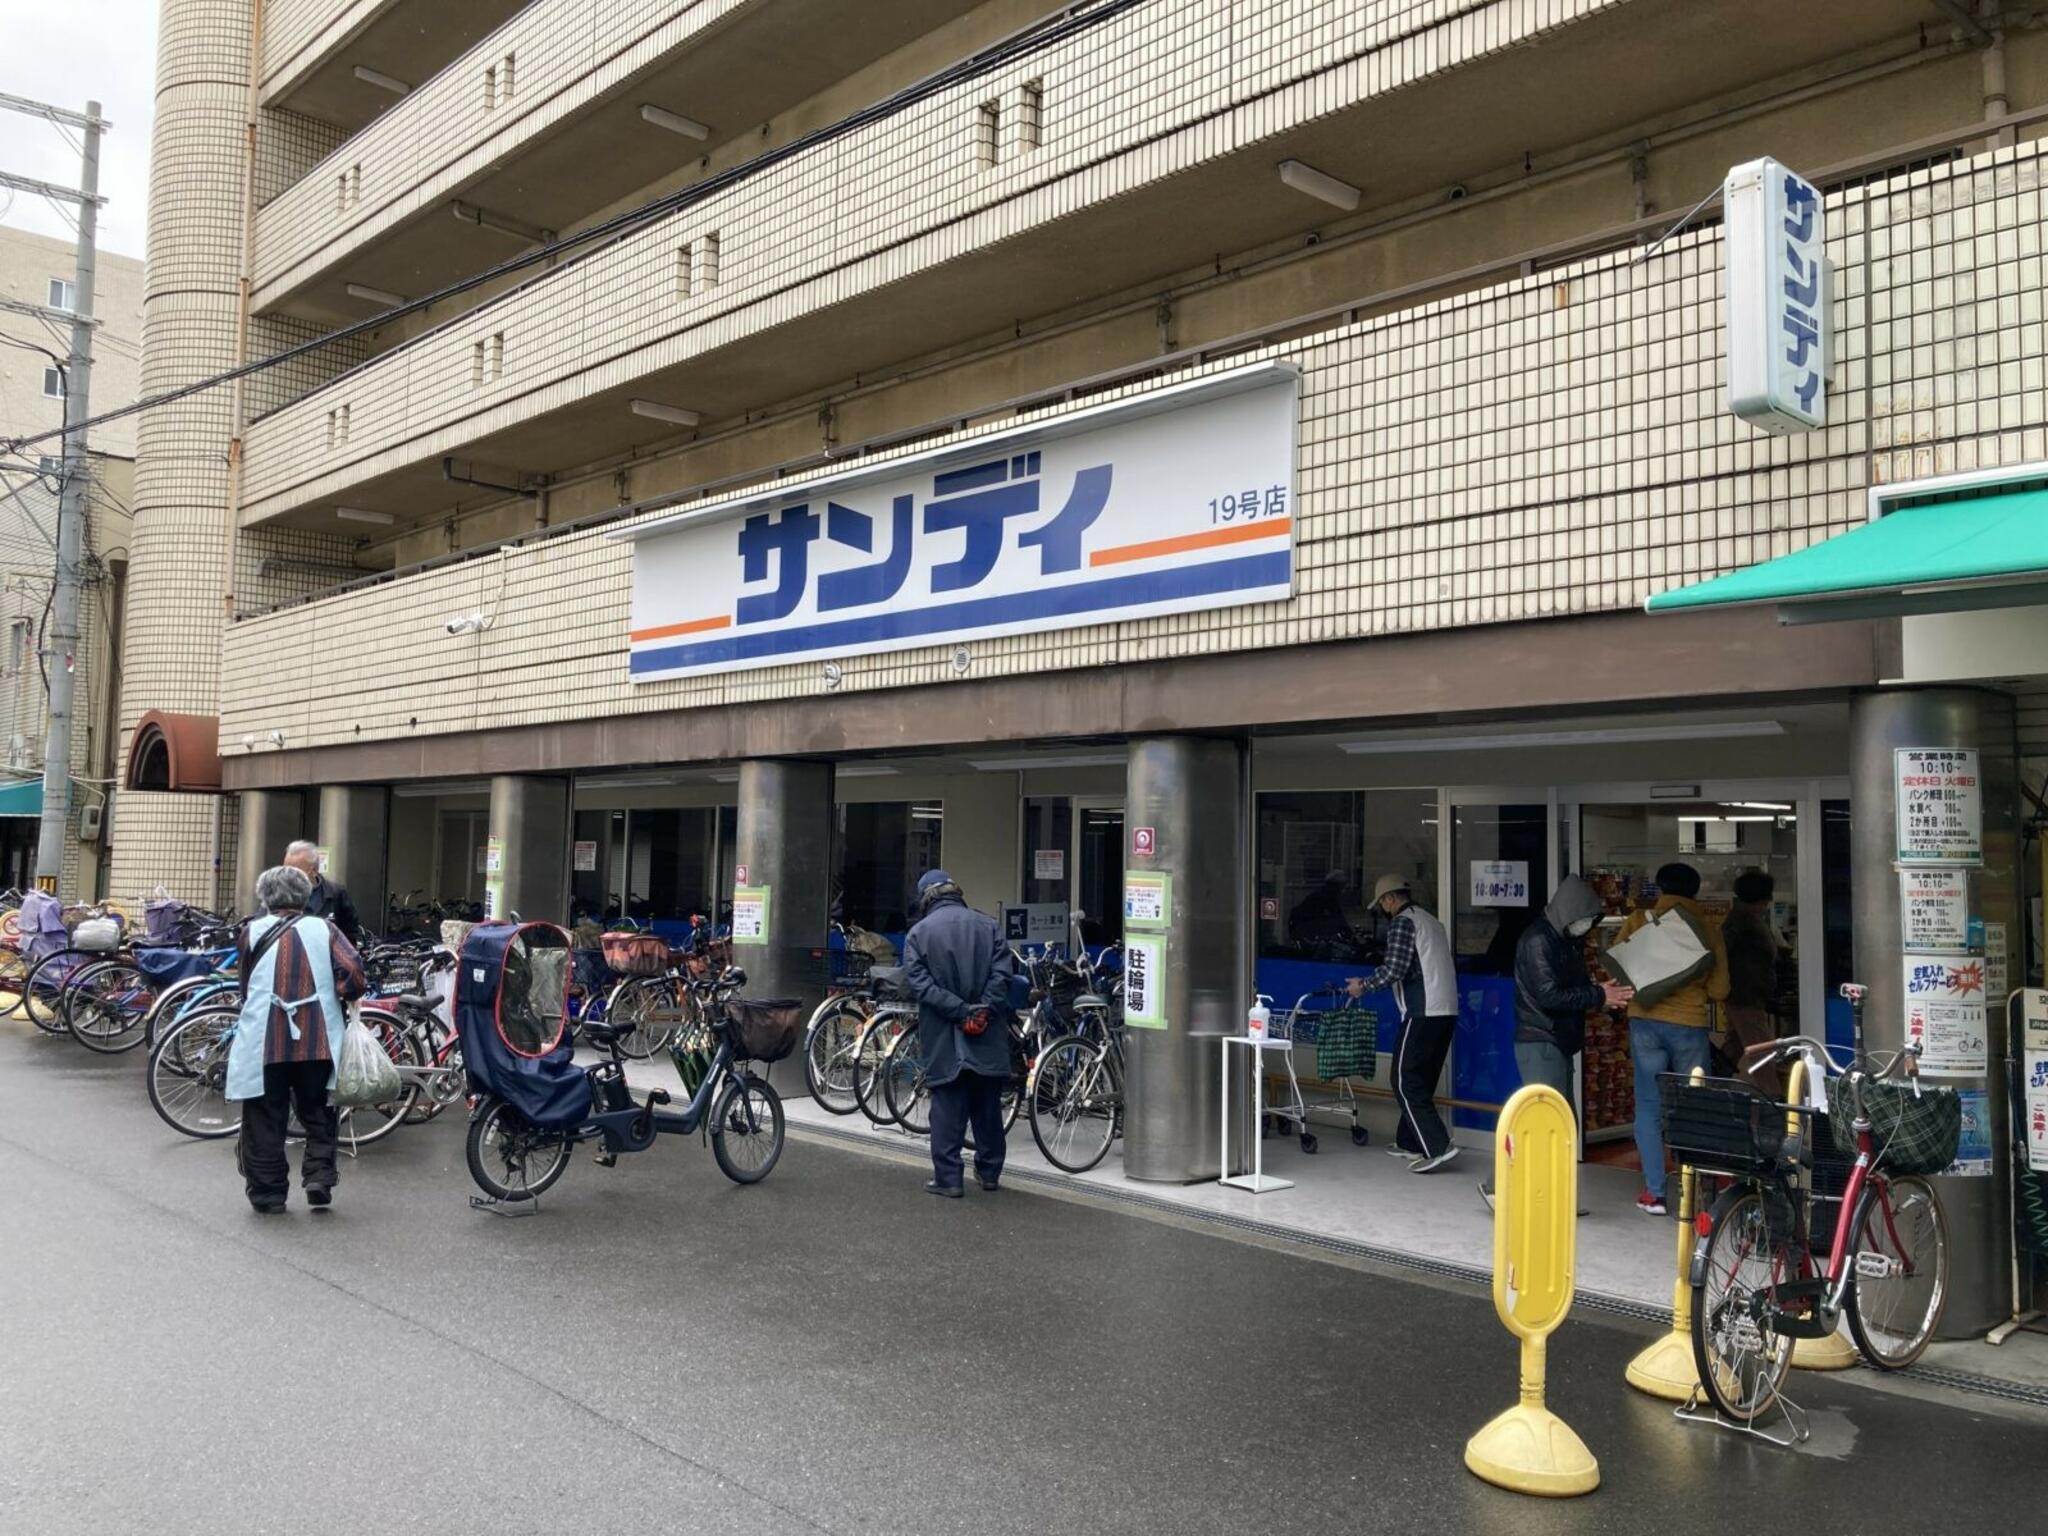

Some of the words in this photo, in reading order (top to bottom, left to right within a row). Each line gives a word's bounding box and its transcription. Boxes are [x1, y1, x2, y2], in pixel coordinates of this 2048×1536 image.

[1783, 175, 1819, 414] サンディ
[1209, 485, 1287, 524] 19号店
[737, 451, 1114, 626] サンディ
[1128, 949, 1145, 1011] 駐輪場
[1909, 974, 1959, 993] セルフサービス
[1914, 964, 1944, 980] 空気入れ
